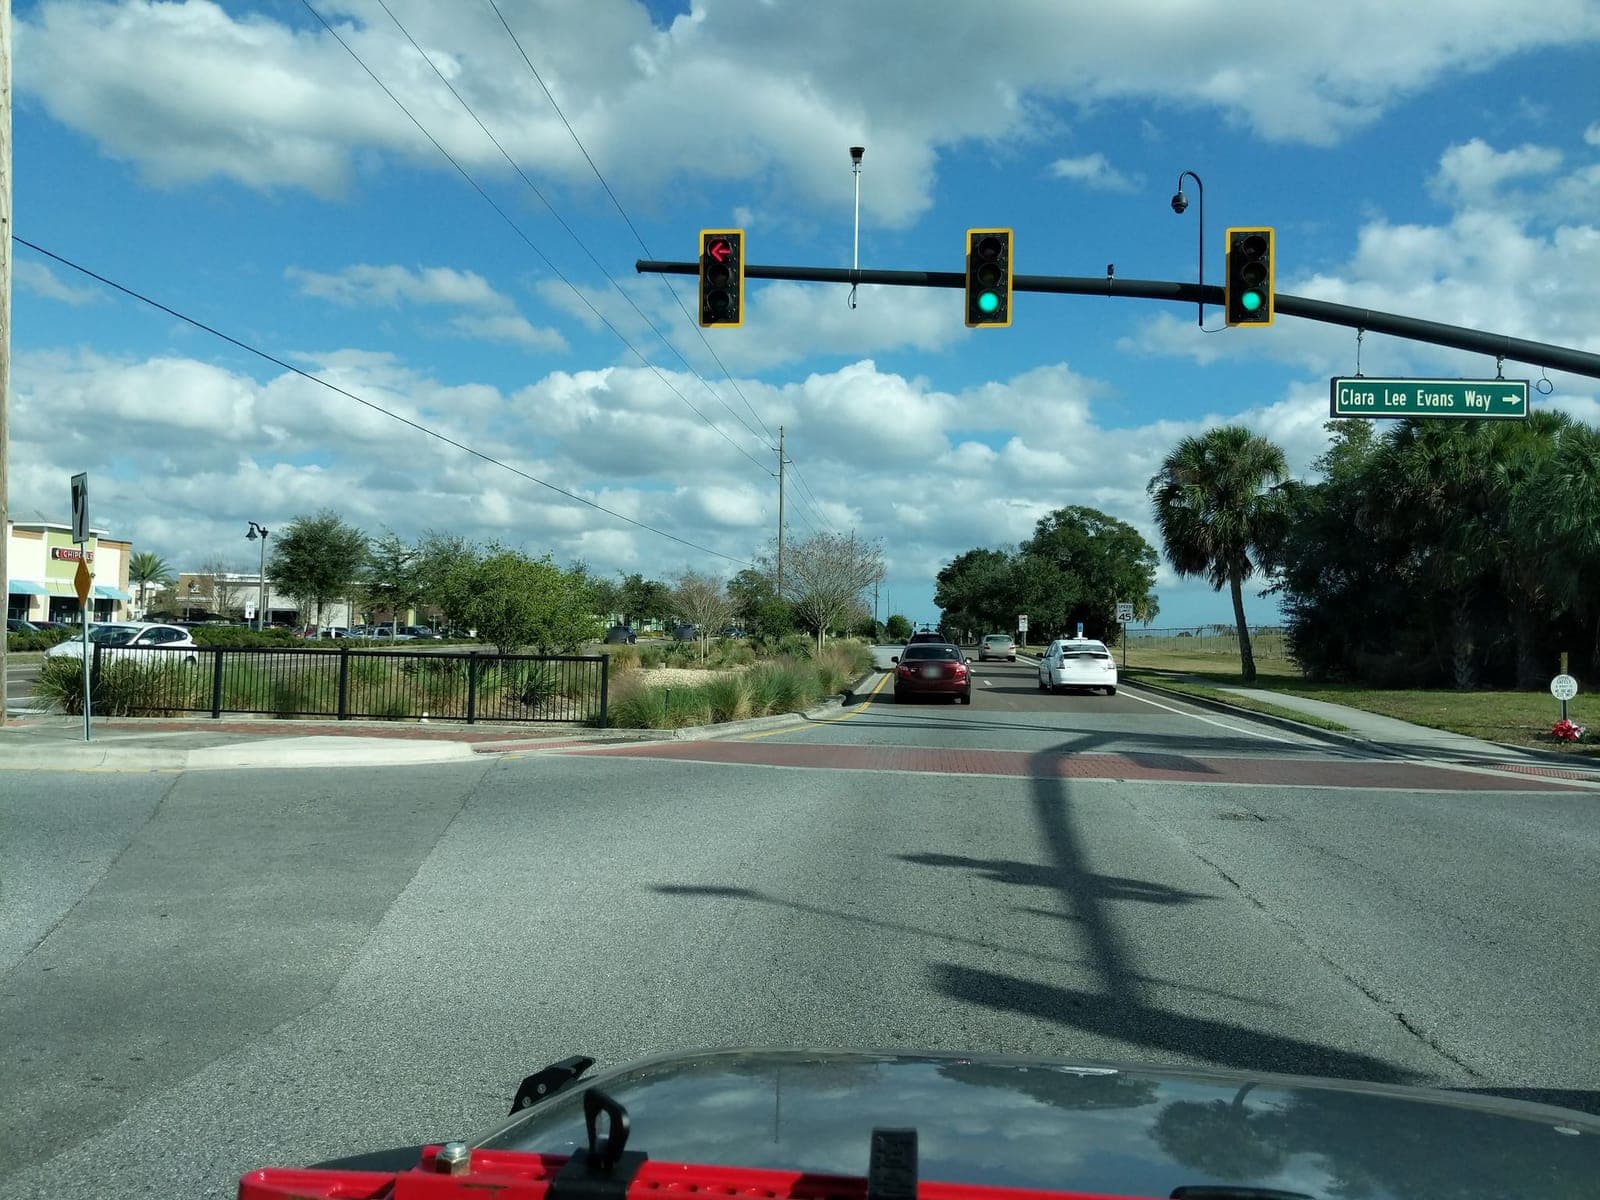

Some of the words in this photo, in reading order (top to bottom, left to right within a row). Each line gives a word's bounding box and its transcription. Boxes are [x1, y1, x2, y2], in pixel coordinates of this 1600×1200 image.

[1341, 388, 1375, 406] Clara
[1384, 388, 1407, 406] Lee
[1417, 389, 1454, 407] Evans
[1464, 390, 1492, 412] Way
[63, 550, 94, 560] CHIPOLE
[1118, 612, 1132, 622] 45
